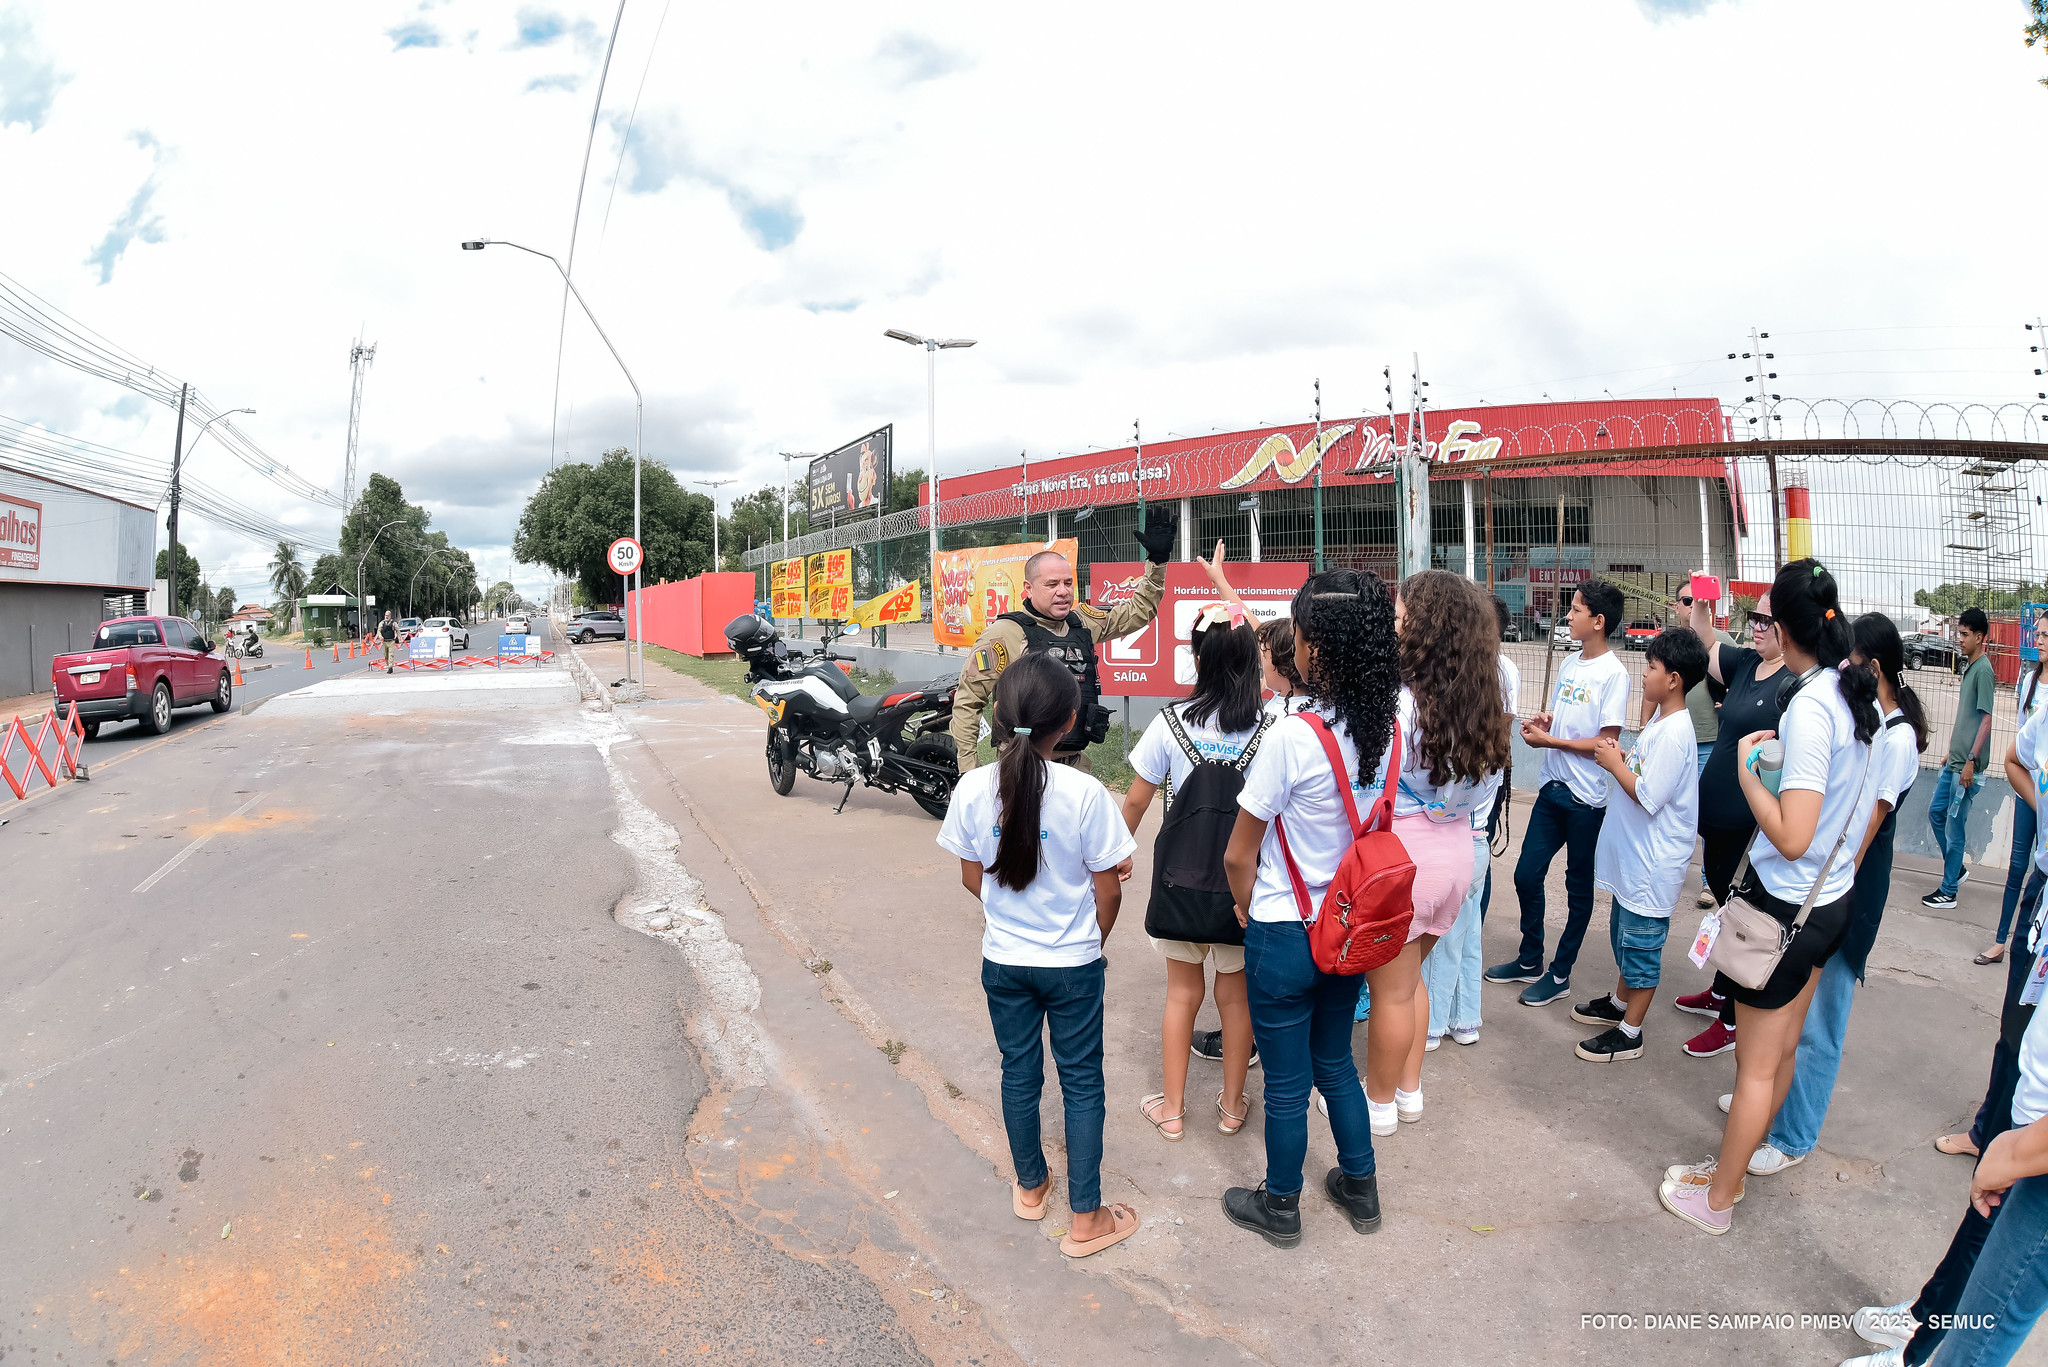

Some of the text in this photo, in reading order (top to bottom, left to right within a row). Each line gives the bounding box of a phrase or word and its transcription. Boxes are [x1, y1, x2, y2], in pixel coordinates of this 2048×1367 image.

[1041, 479, 1067, 494] Nova
[1069, 474, 1092, 490] Era,
[1094, 468, 1108, 486] tá
[1109, 470, 1130, 485] em
[617, 546, 634, 560] 50
[1539, 571, 1581, 581] ENTADA
[1174, 586, 1209, 595] Horário
[1235, 587, 1298, 595] uncionamento
[1113, 669, 1148, 682] SAÍDA
